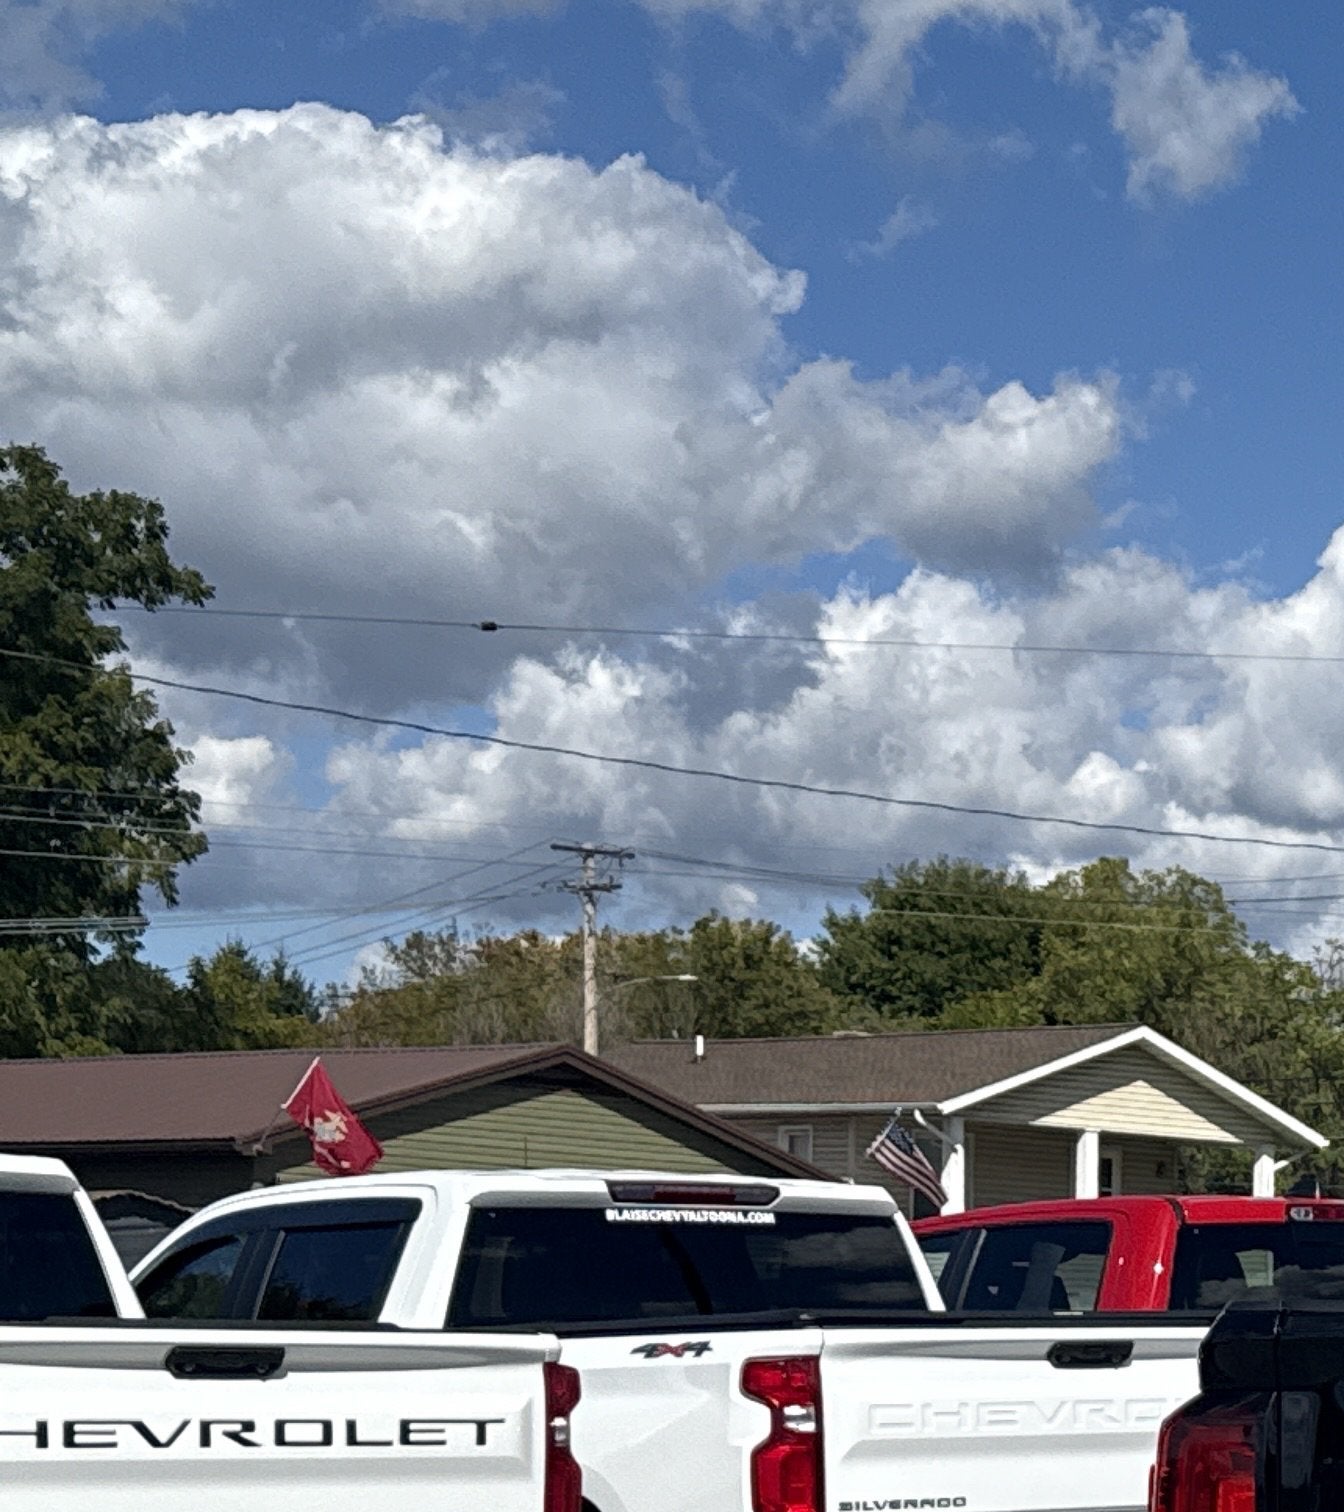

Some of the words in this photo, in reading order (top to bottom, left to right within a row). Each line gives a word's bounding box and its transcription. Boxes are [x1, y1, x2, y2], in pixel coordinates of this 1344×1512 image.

[868, 1398, 1182, 1435] CHEVRO
[0, 1418, 506, 1448] HEVROLET
[838, 1497, 967, 1512] SILVERADO
